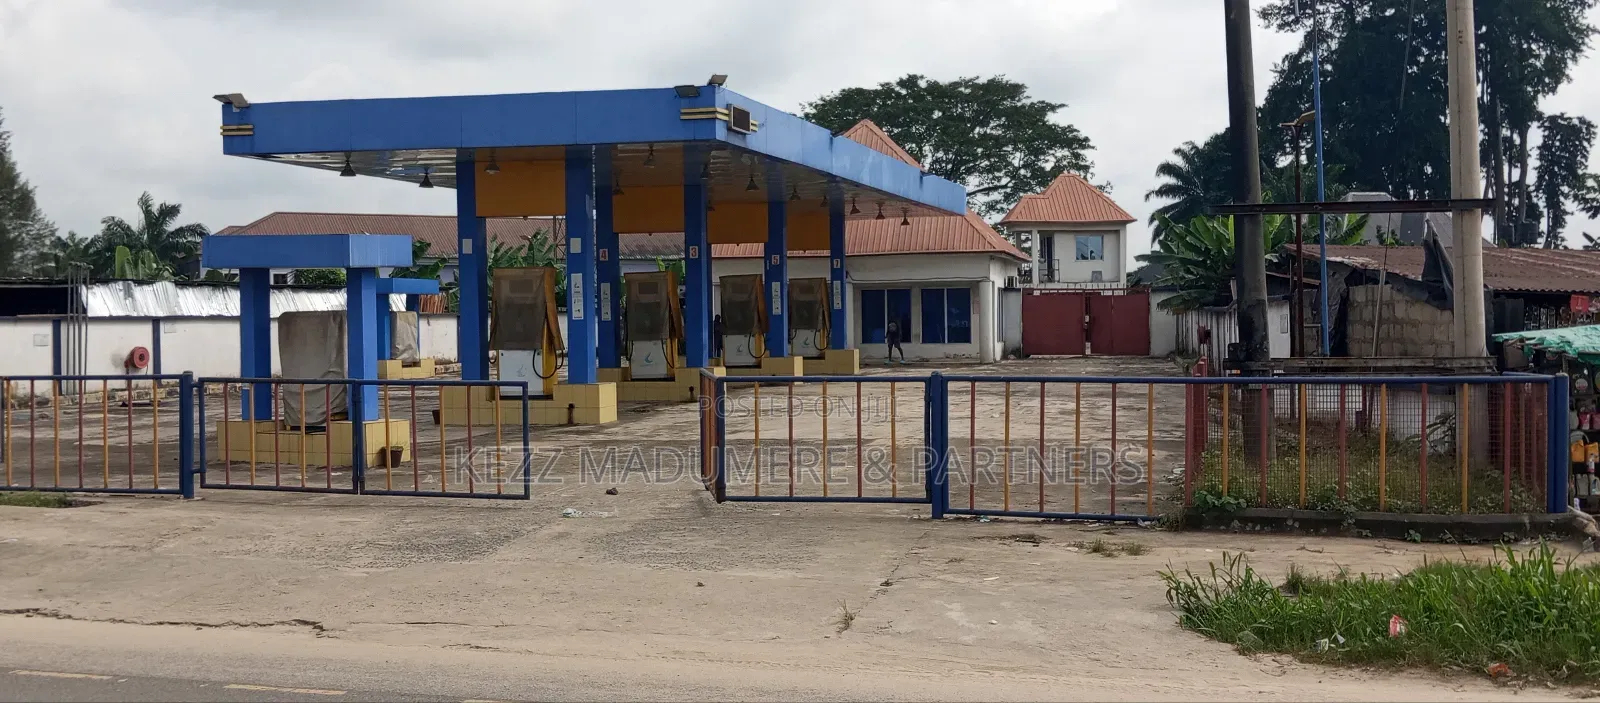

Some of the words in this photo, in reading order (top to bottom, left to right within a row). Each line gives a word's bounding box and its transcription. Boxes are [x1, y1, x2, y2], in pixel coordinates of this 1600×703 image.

[600, 249, 607, 260] 4
[691, 247, 697, 257] 3
[773, 256, 779, 265] 5
